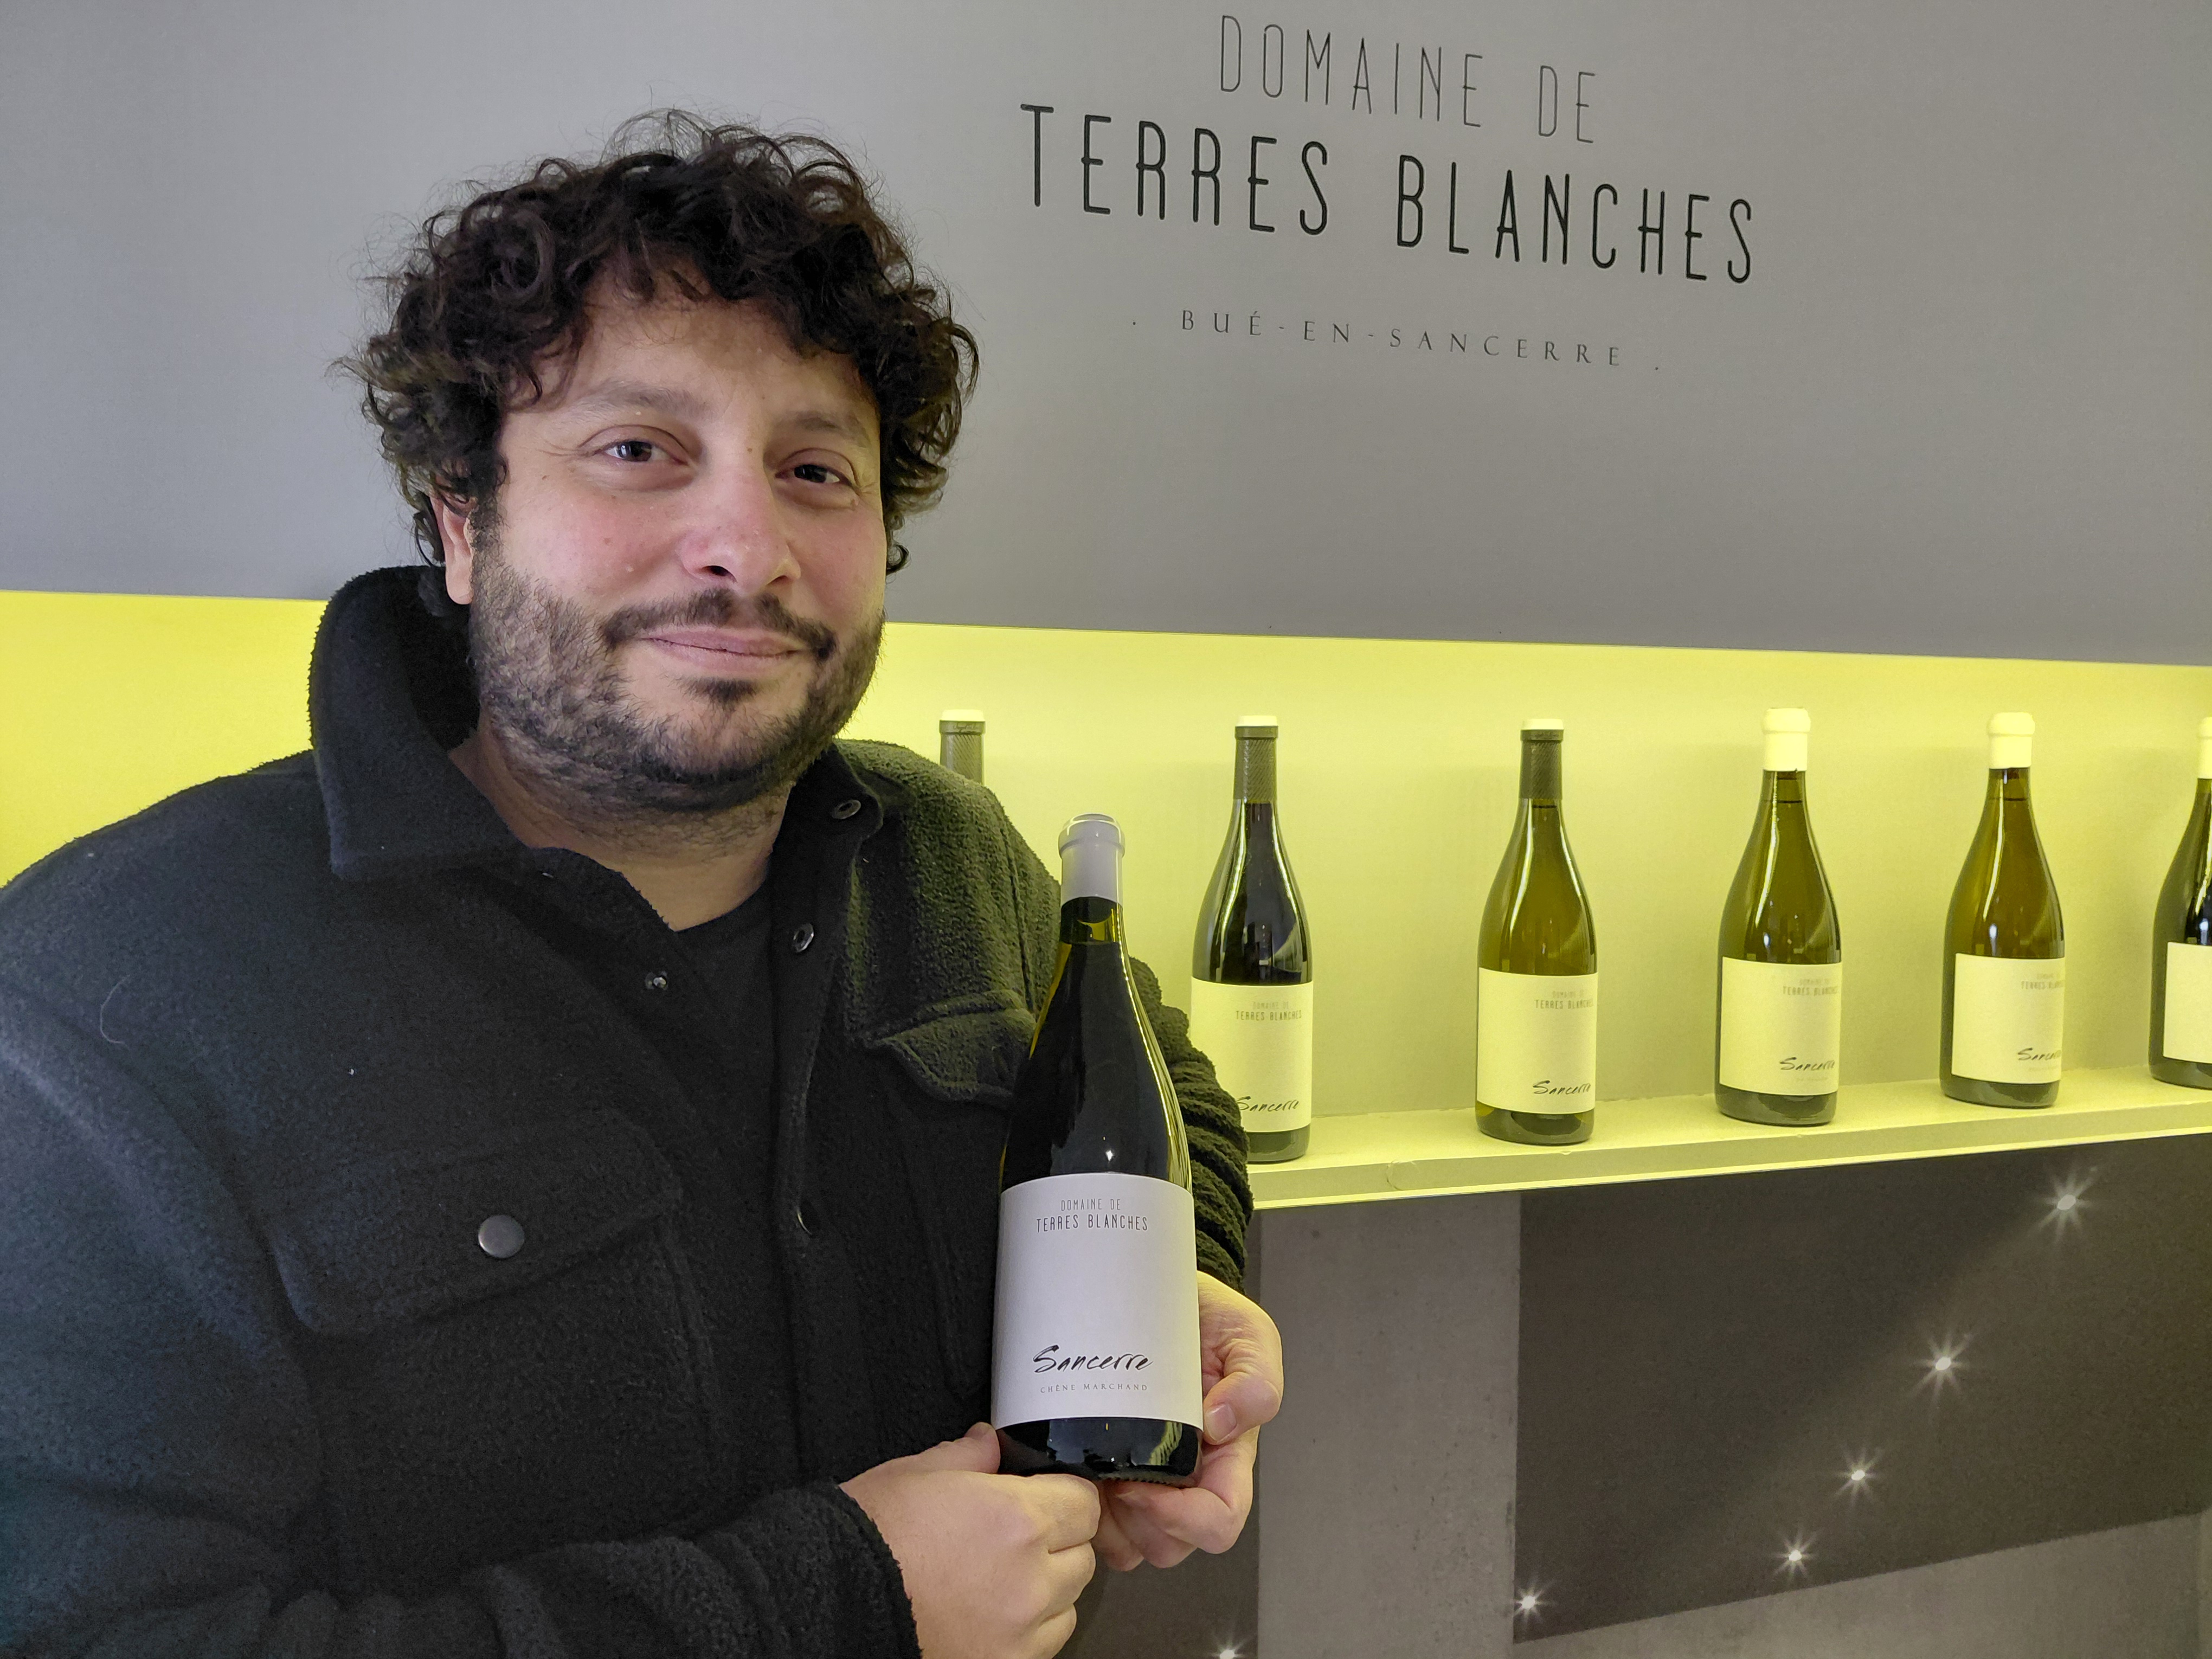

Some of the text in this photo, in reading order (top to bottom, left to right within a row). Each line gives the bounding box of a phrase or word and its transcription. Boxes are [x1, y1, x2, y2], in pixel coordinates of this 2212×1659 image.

[1220, 14, 1597, 144] DOMAINE DE
[1020, 103, 1752, 285] TERRES BLANCHES
[1236, 1010, 1265, 1021] TERRES
[1060, 1198, 1121, 1212] DOMAINE DE
[1036, 1213, 1148, 1233] TERRES BLANCHES
[1032, 1344, 1154, 1374] Sancerre
[1040, 1382, 1148, 1393] CHÊNE MARCHAND
